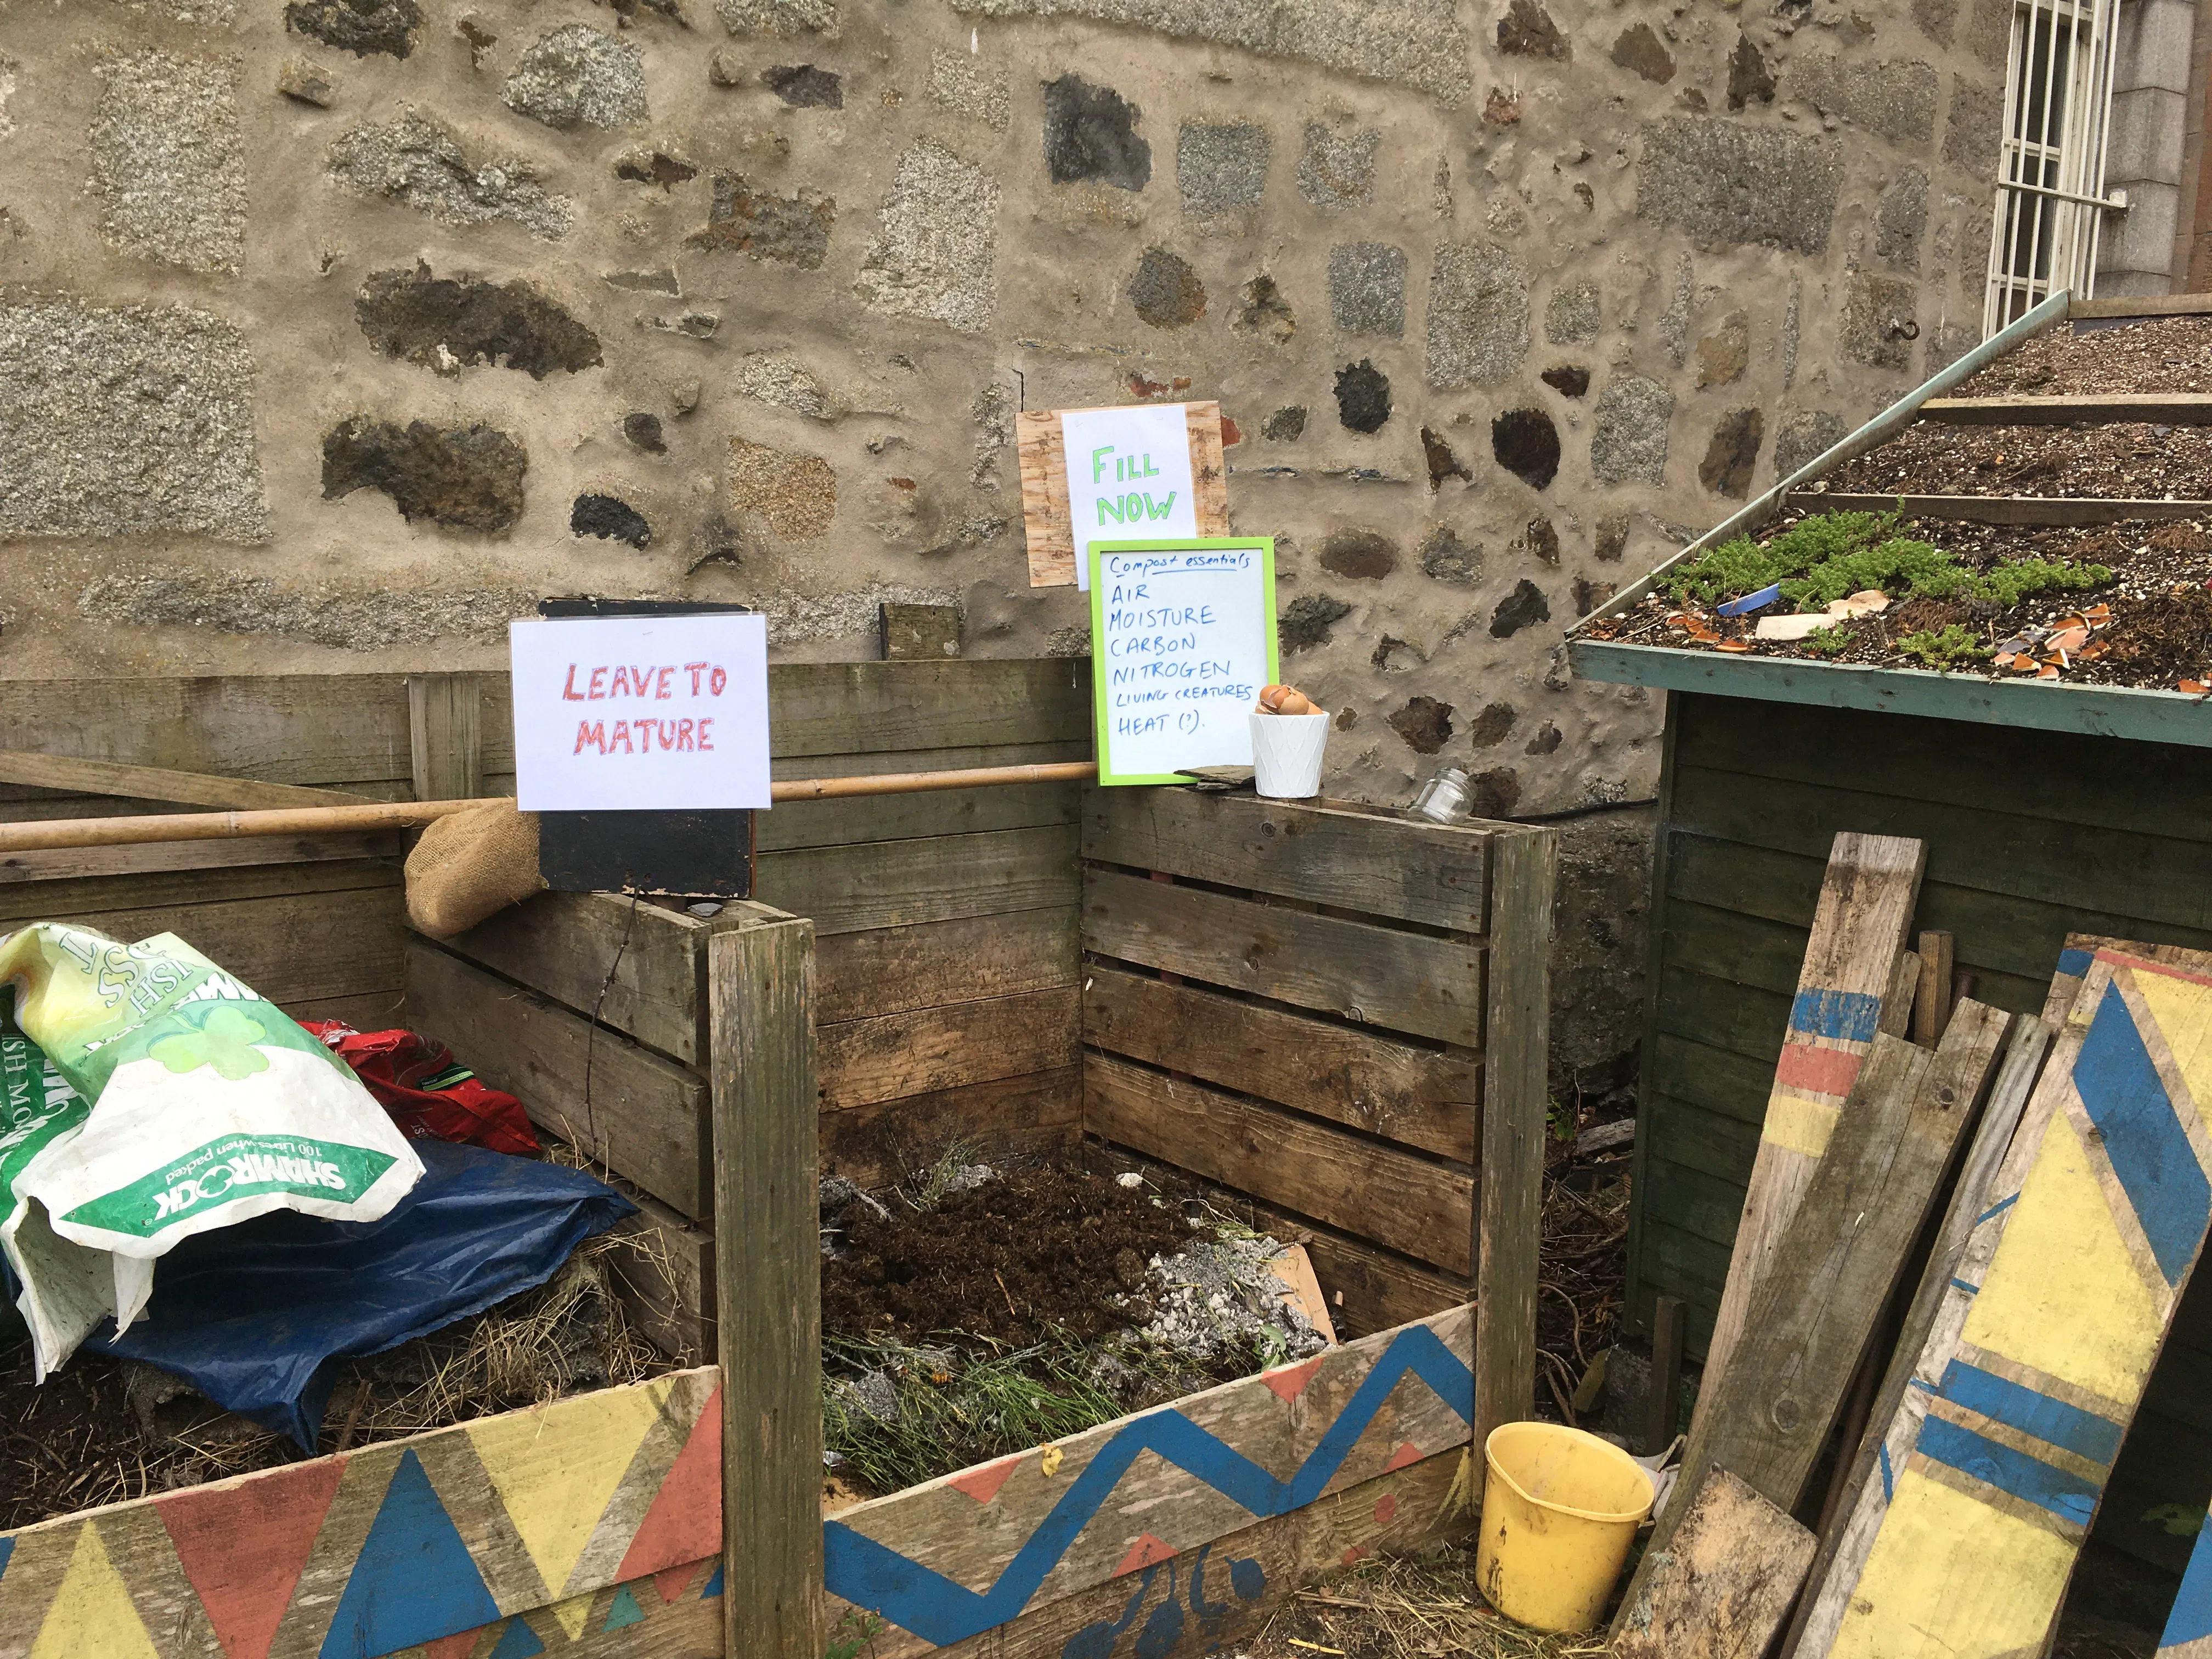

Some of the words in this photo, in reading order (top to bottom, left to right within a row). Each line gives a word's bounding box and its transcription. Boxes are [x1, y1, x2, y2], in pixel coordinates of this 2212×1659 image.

[1093, 446, 1160, 484] FILL
[1097, 492, 1177, 526] NOW
[1110, 555, 1178, 578] Compost
[1186, 553, 1250, 569] essentials
[1111, 584, 1150, 605] AIR
[1109, 605, 1216, 631] MOISTURE
[1111, 633, 1195, 656] CARBON
[562, 663, 678, 702] LEAVE
[684, 662, 727, 697] TO
[1114, 660, 1230, 686] NITROGEN
[1116, 690, 1170, 708] LIVING
[1175, 685, 1254, 701] CREATURES
[573, 718, 715, 755] MATURE
[1119, 714, 1170, 736] HEAT
[217, 1139, 255, 1155] when
[257, 1141, 295, 1155] Litres
[298, 1142, 323, 1156] 100
[165, 1148, 213, 1185] packed
[151, 1153, 347, 1221] SHAMROCK
